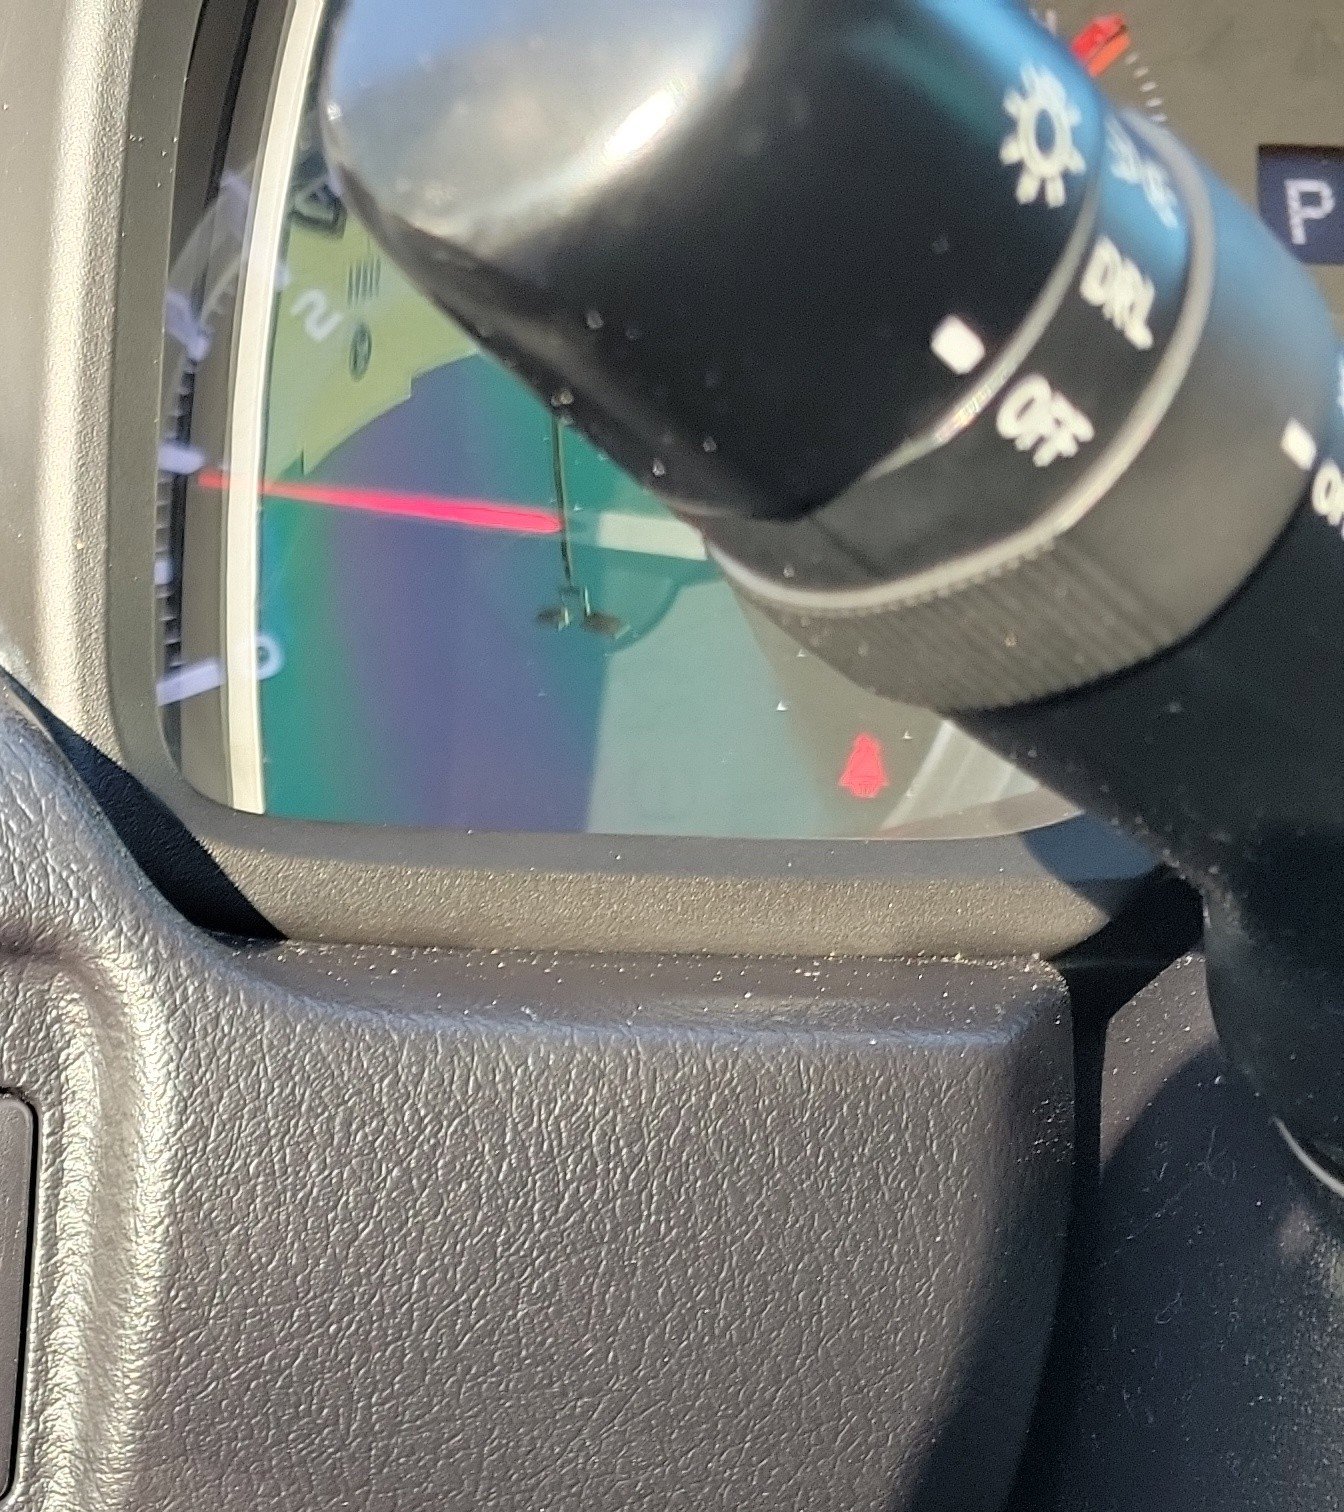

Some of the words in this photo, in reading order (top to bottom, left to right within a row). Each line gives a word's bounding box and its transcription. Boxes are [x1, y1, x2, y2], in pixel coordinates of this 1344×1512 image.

[1284, 178, 1336, 246] P
[291, 287, 346, 342] 2
[1079, 234, 1156, 350] DRL
[995, 372, 1096, 468] OFF
